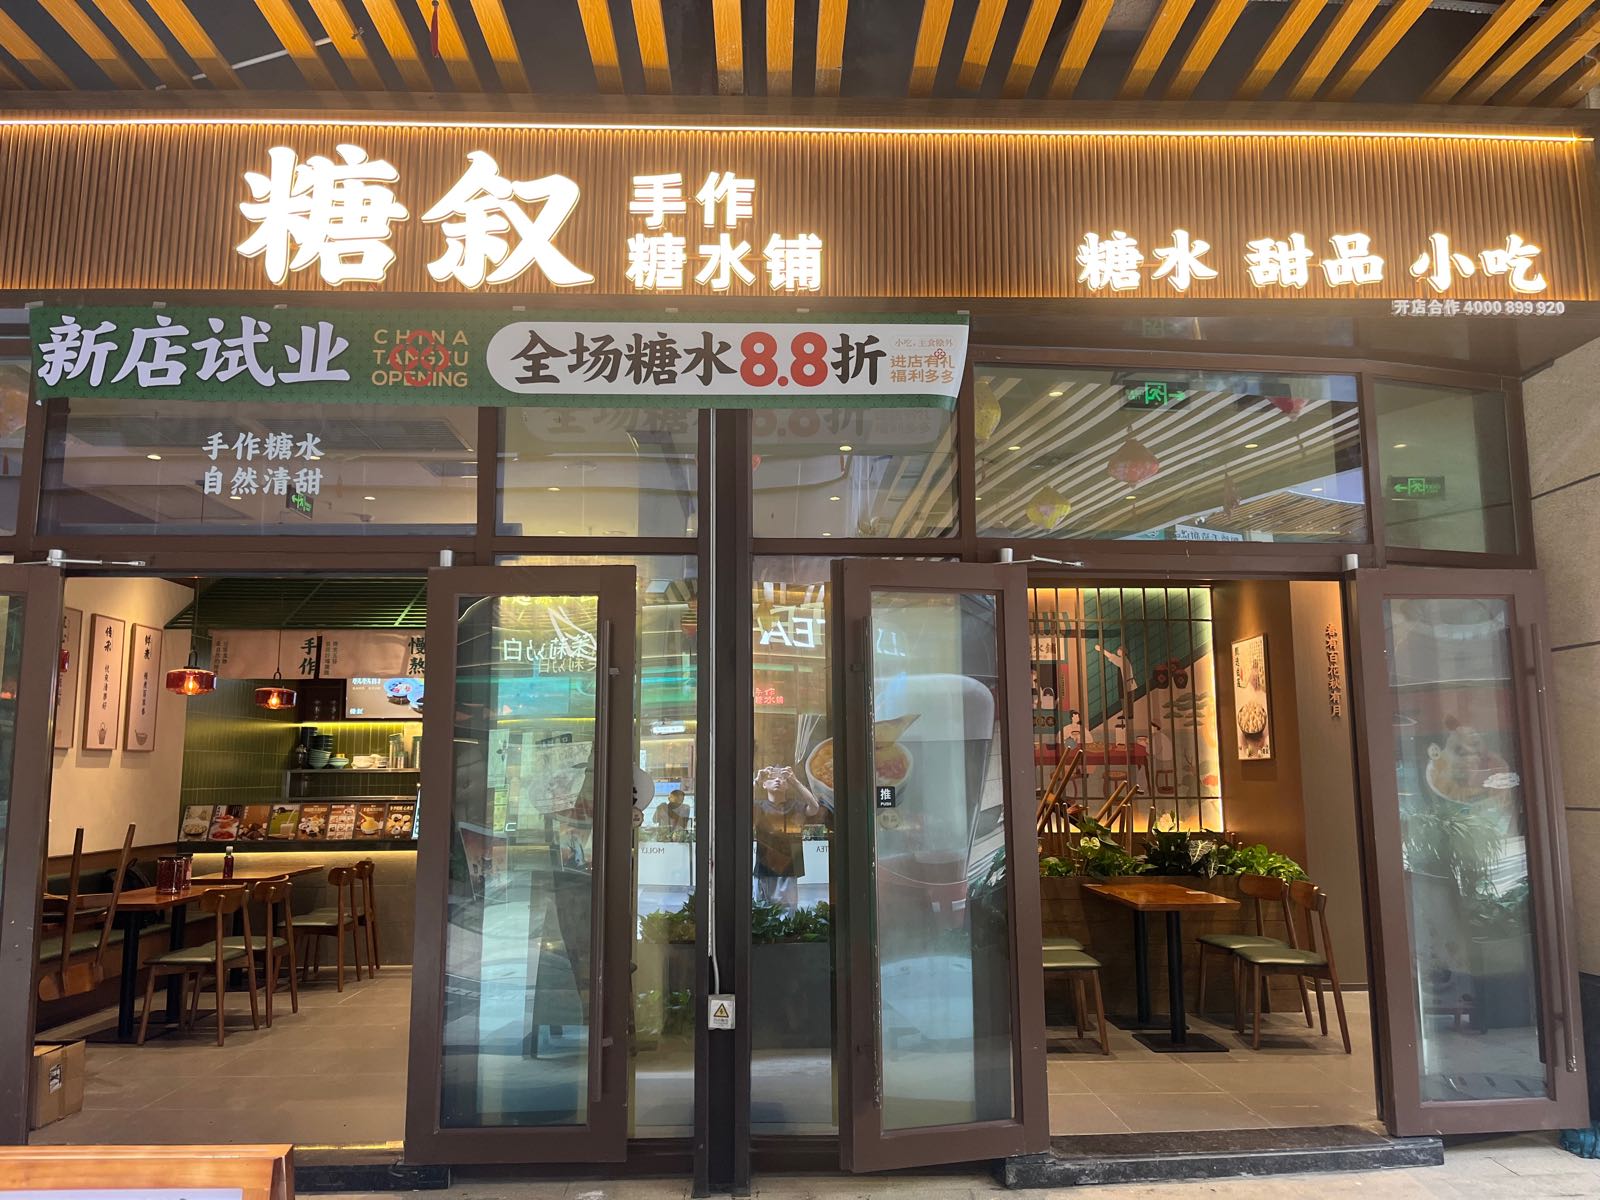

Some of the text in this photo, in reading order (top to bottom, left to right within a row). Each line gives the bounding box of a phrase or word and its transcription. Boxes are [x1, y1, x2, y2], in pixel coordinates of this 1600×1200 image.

[629, 171, 756, 229] 手作
[237, 144, 594, 289] 糖叙
[625, 232, 823, 292] 糖水铺
[1076, 229, 1547, 293] 糖水 甜品 小吃
[1392, 299, 1566, 316] 开店合作 4000 899 920
[37, 315, 352, 389] 新店试业
[373, 328, 469, 346] CHINA
[372, 349, 469, 367] TANGXU
[510, 329, 887, 387] 全场糖水8.8折
[890, 354, 956, 369] 进店有礼
[371, 370, 468, 387] OPENING
[890, 369, 955, 384] 福利多多
[202, 431, 326, 461] 手作糖水
[202, 466, 324, 496] 自然清甜
[299, 637, 317, 676] 手作
[408, 637, 426, 675] 慢熬
[880, 787, 892, 800] 推
